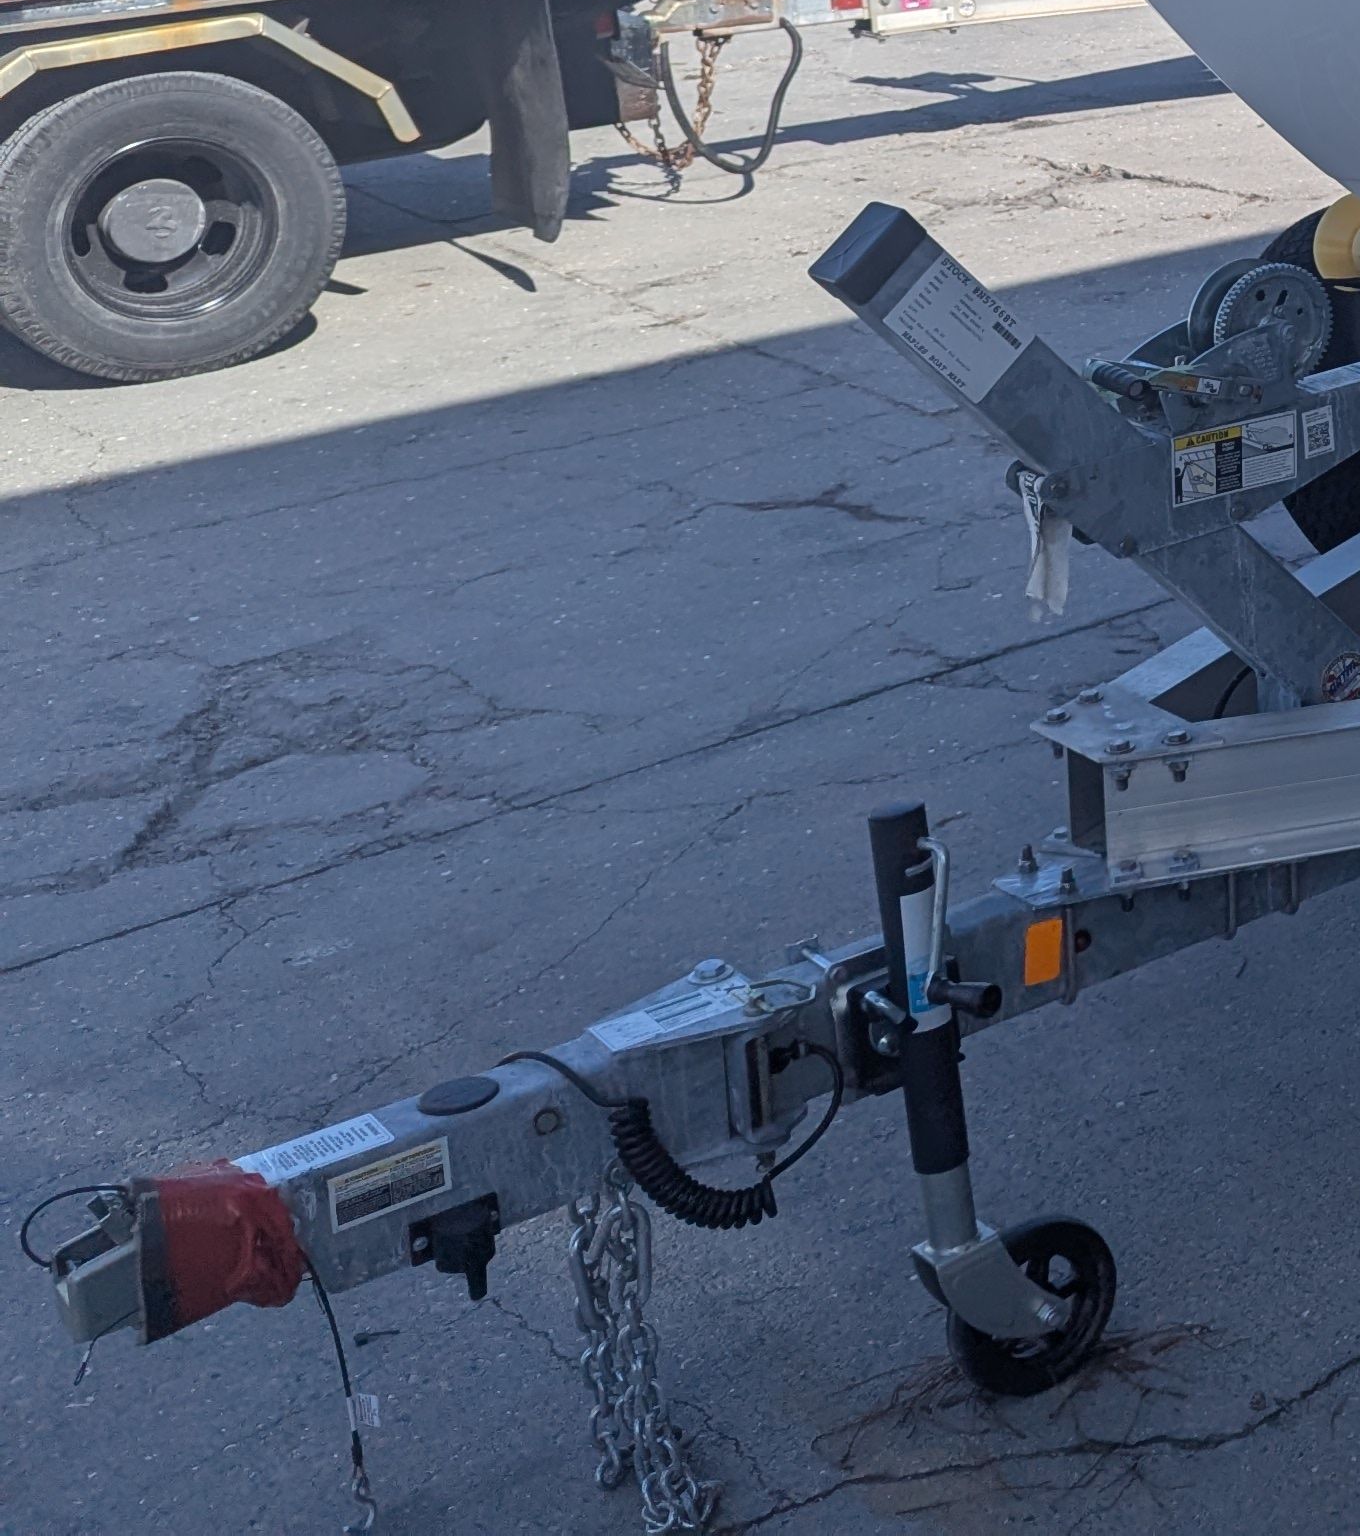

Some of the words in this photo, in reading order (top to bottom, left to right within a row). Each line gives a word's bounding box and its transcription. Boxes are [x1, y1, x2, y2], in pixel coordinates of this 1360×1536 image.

[940, 257, 972, 286] STOCK
[901, 330, 929, 355] NAPLES
[929, 355, 947, 372] BOAT
[947, 371, 967, 389] MART
[1196, 430, 1229, 444] CAUTION
